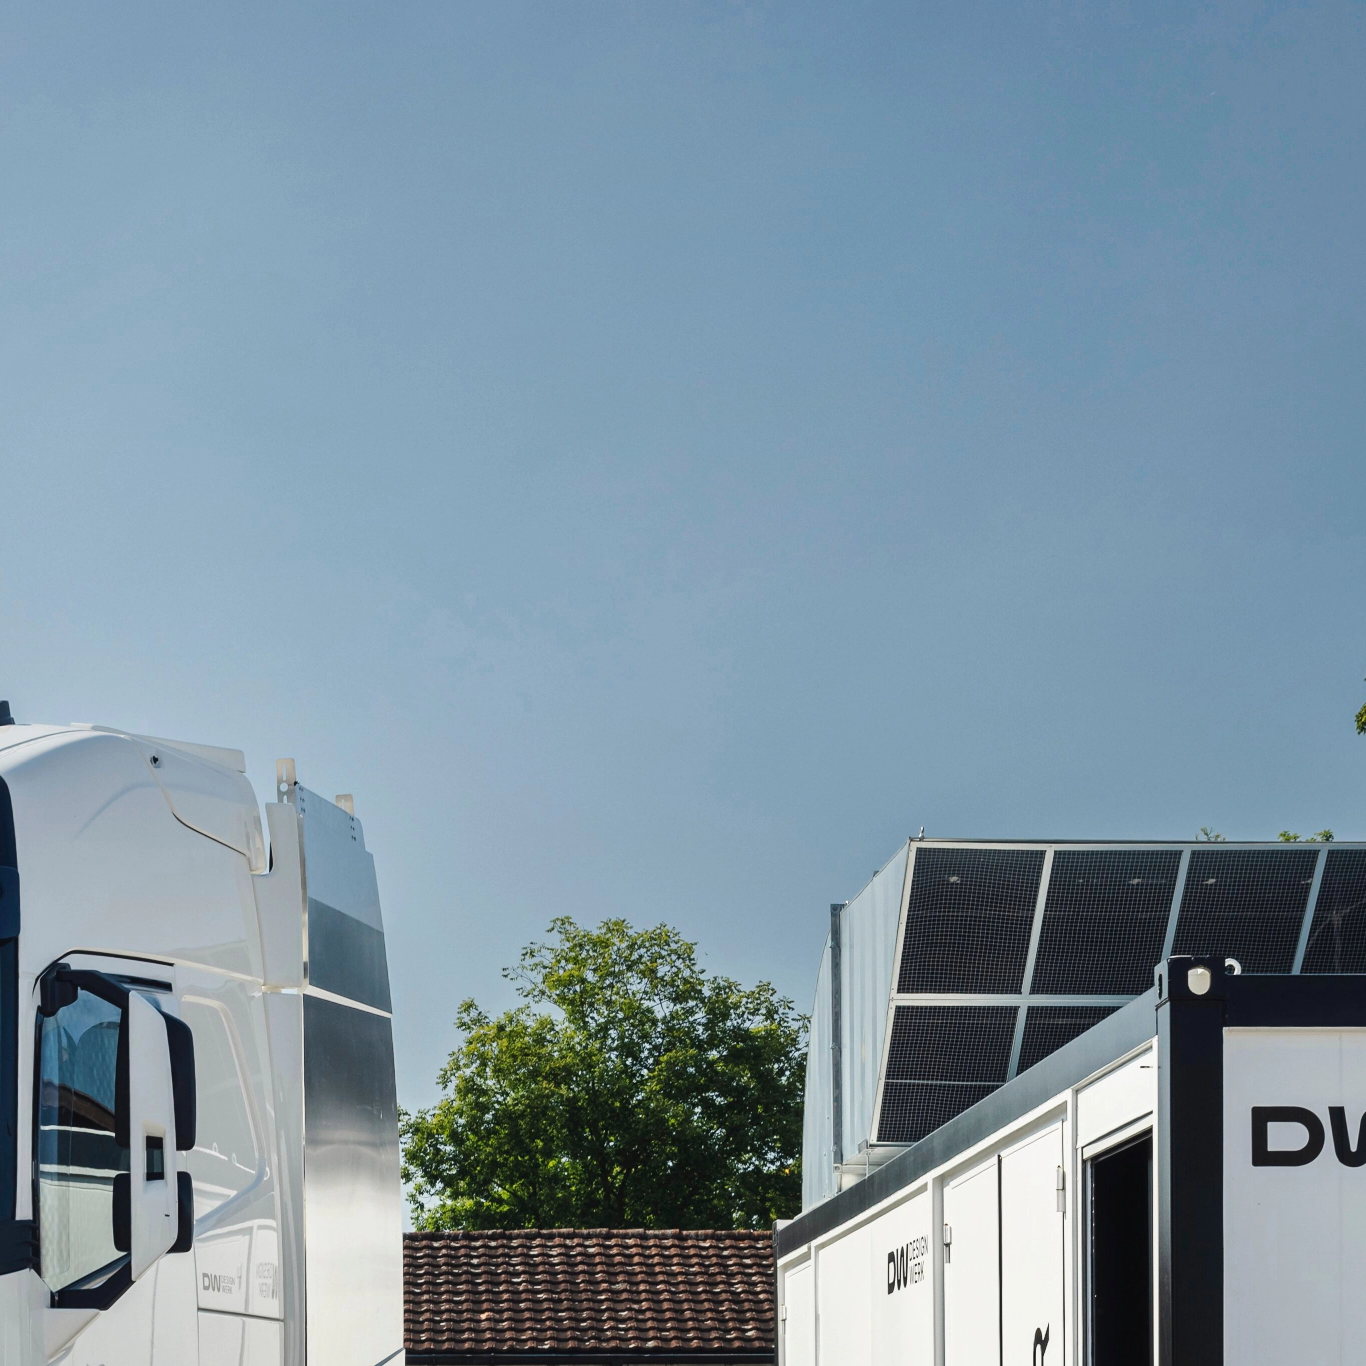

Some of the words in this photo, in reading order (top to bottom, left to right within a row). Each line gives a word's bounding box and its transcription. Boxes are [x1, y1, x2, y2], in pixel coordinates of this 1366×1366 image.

[908, 1234, 929, 1262] DESIGN
[202, 1272, 220, 1293] DW
[887, 1243, 909, 1296] DW
[908, 1260, 925, 1286] WERK
